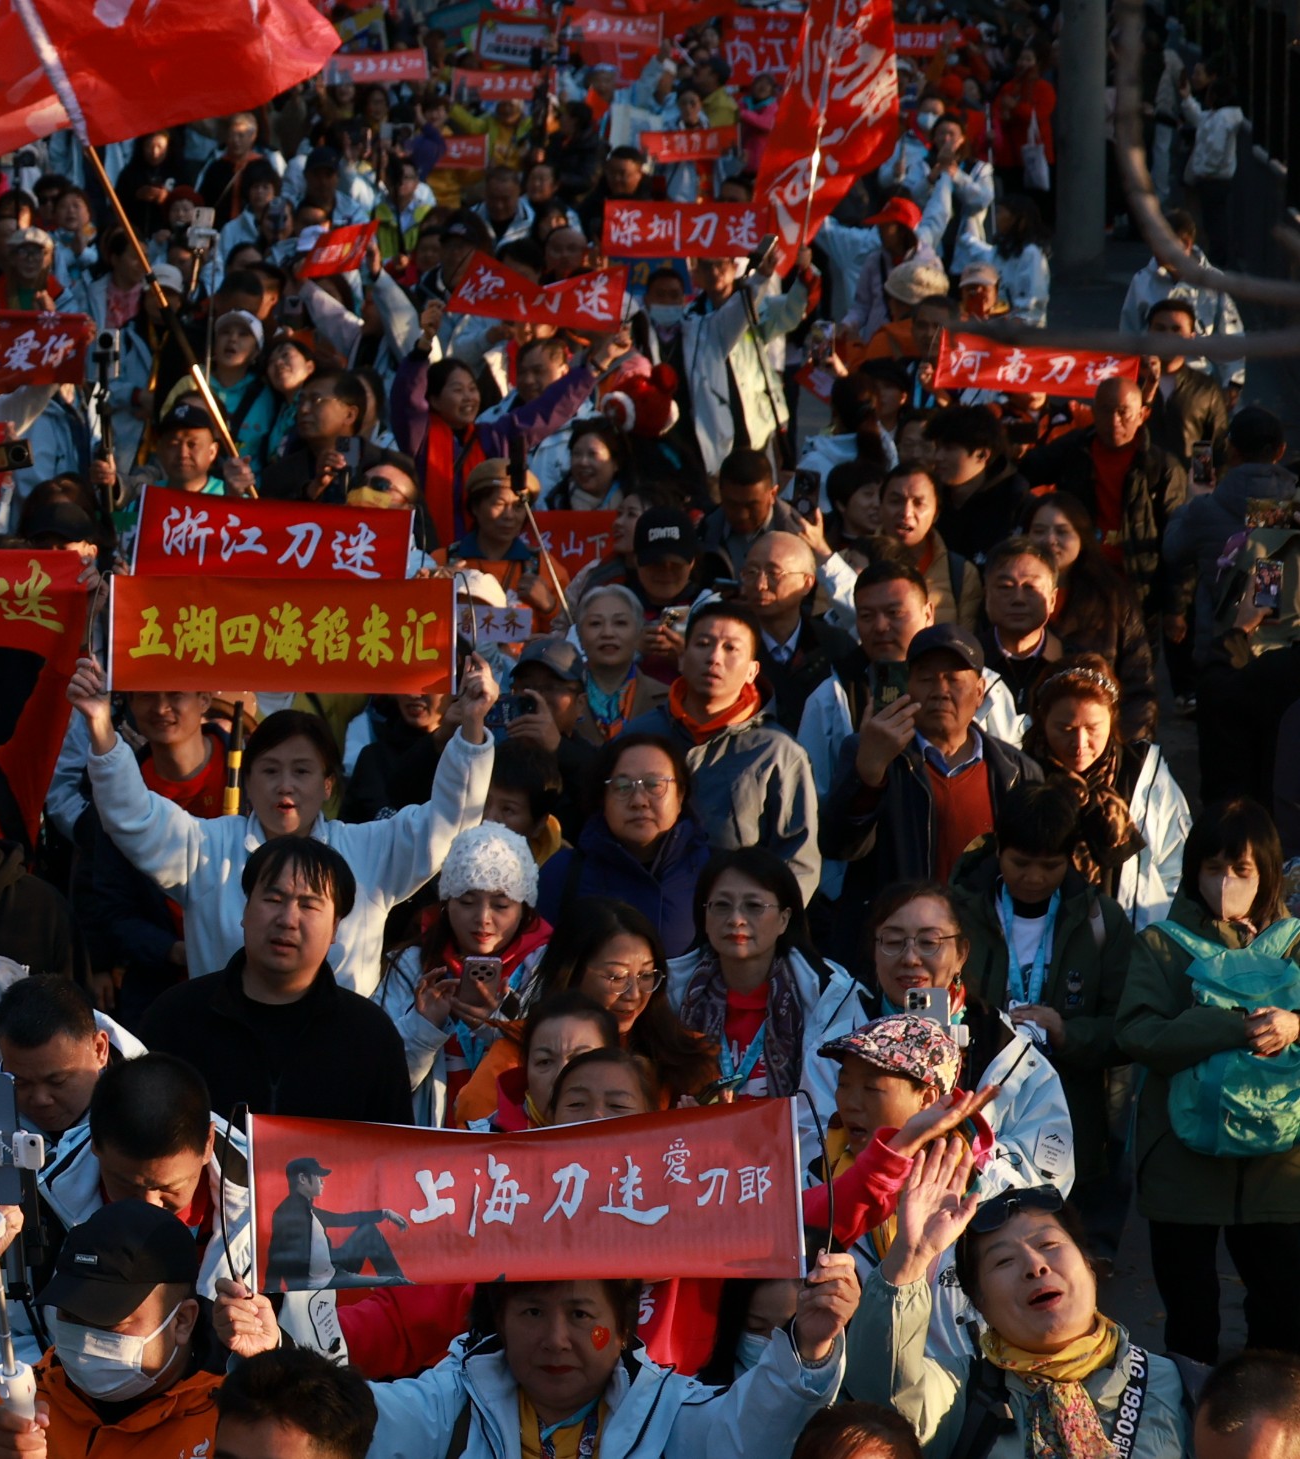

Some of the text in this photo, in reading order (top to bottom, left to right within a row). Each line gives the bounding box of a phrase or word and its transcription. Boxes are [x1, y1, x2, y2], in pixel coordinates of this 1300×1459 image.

[725, 35, 798, 76] 内江
[610, 208, 760, 251] 深圳刀迷
[950, 342, 1121, 386] 河南刀迷
[163, 506, 382, 581] 浙江刀迷
[128, 603, 440, 668] 五湖四海稻米汇
[409, 1154, 670, 1237] 上海刀迷
[1116, 1386, 1142, 1436] 1980
[1120, 1437, 1132, 1459] CIT
